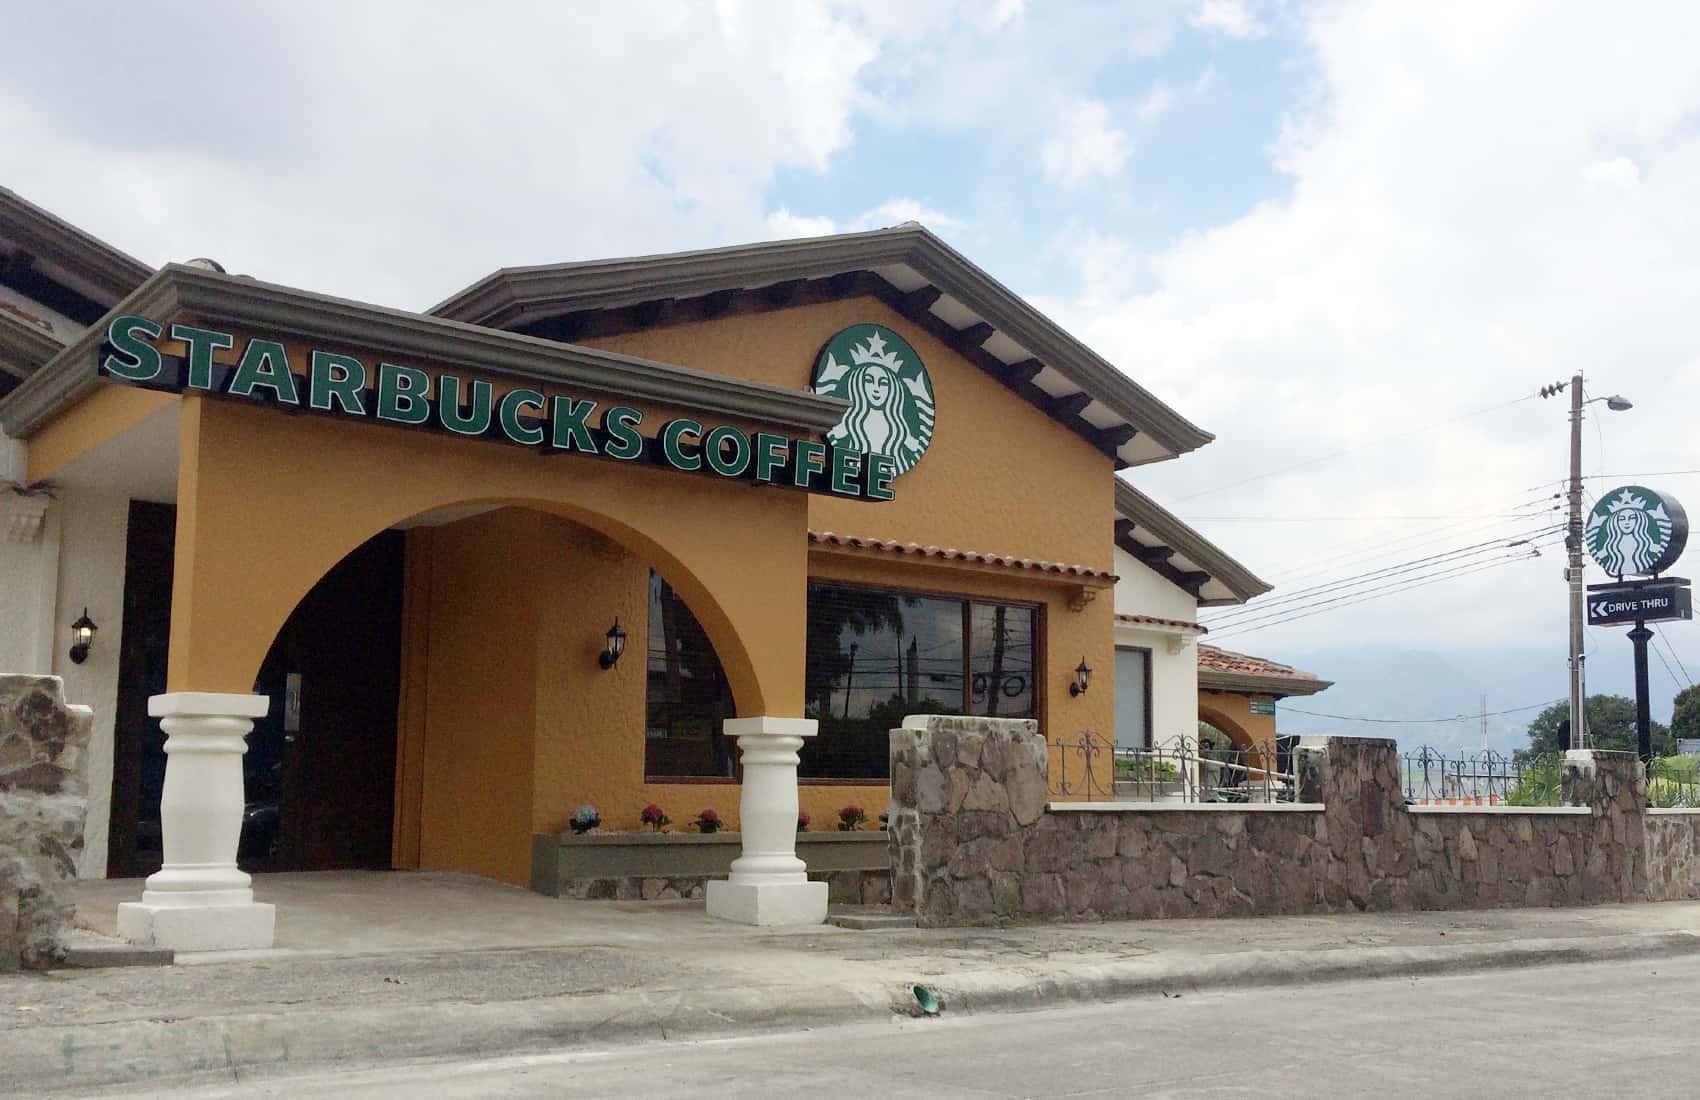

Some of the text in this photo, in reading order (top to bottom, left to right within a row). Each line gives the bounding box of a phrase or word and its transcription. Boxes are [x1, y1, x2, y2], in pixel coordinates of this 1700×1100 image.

[103, 315, 895, 500] STARBUCKS COFFEE
[1608, 597, 1669, 613] DRIVE THRU
